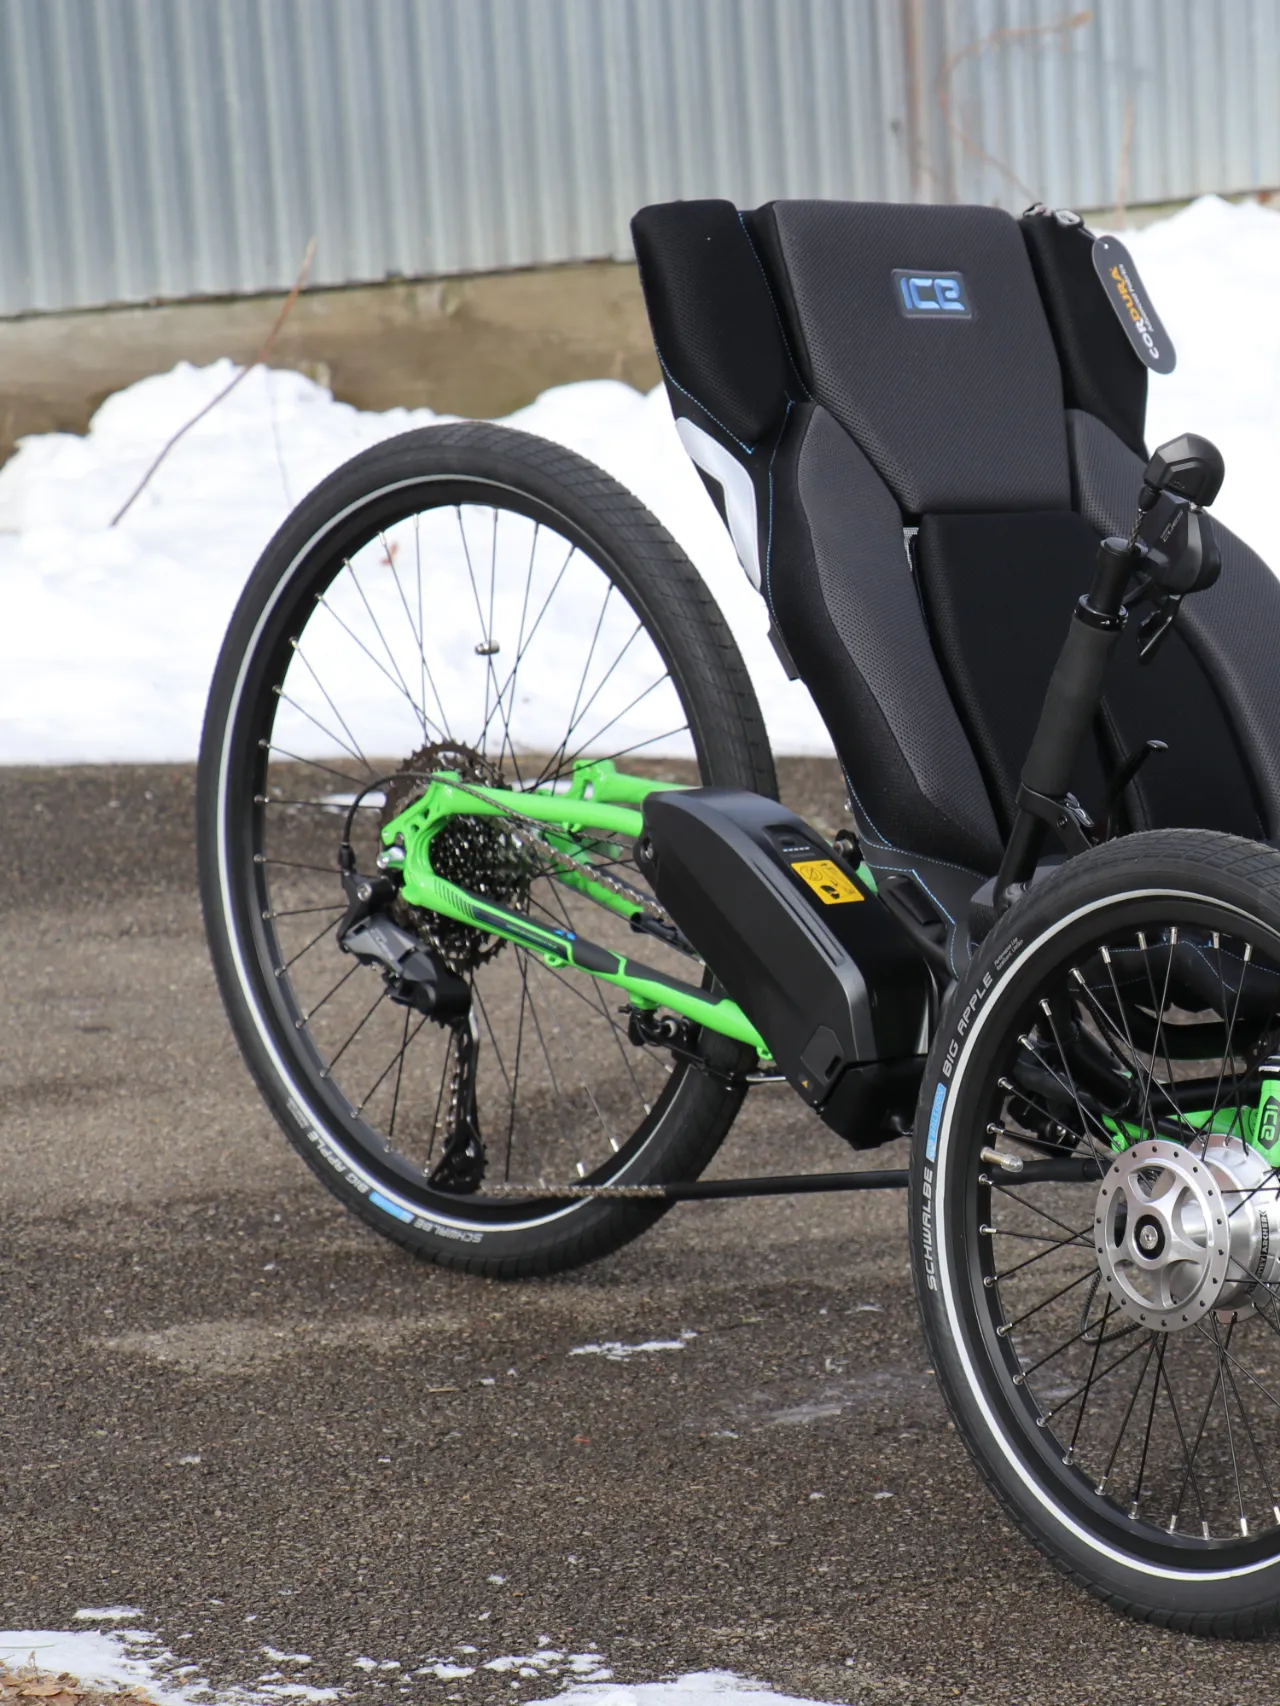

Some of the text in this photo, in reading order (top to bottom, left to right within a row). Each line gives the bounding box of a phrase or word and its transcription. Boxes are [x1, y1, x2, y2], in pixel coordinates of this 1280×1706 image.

[900, 277, 965, 311] ICE
[1110, 265, 1160, 359] CORDURA
[922, 1166, 938, 1292] SCHWALBE
[942, 1039, 959, 1078] BIG
[957, 971, 993, 1036] APPLE
[1260, 1104, 1279, 1141] ICE
[307, 1130, 371, 1194] BIG APPLE
[413, 1217, 484, 1244] SCHWALBE
[1260, 1213, 1269, 1253] ARCHER
